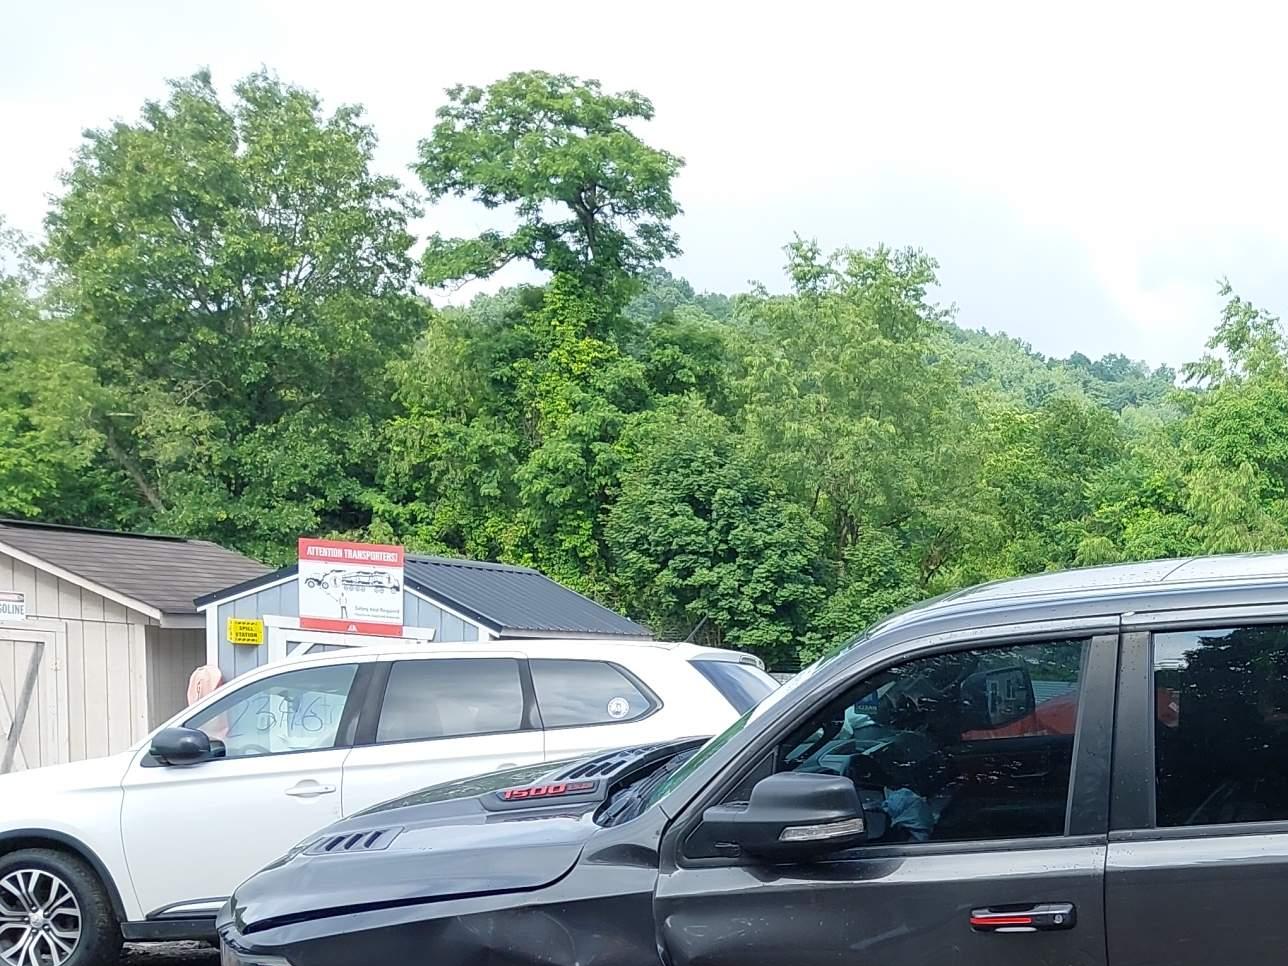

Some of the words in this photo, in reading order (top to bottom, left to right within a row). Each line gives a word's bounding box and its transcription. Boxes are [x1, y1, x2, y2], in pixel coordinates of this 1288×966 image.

[306, 546, 343, 558] ATTENTION
[343, 549, 398, 562] TRANSPORTERS!
[504, 783, 567, 800] 1500
